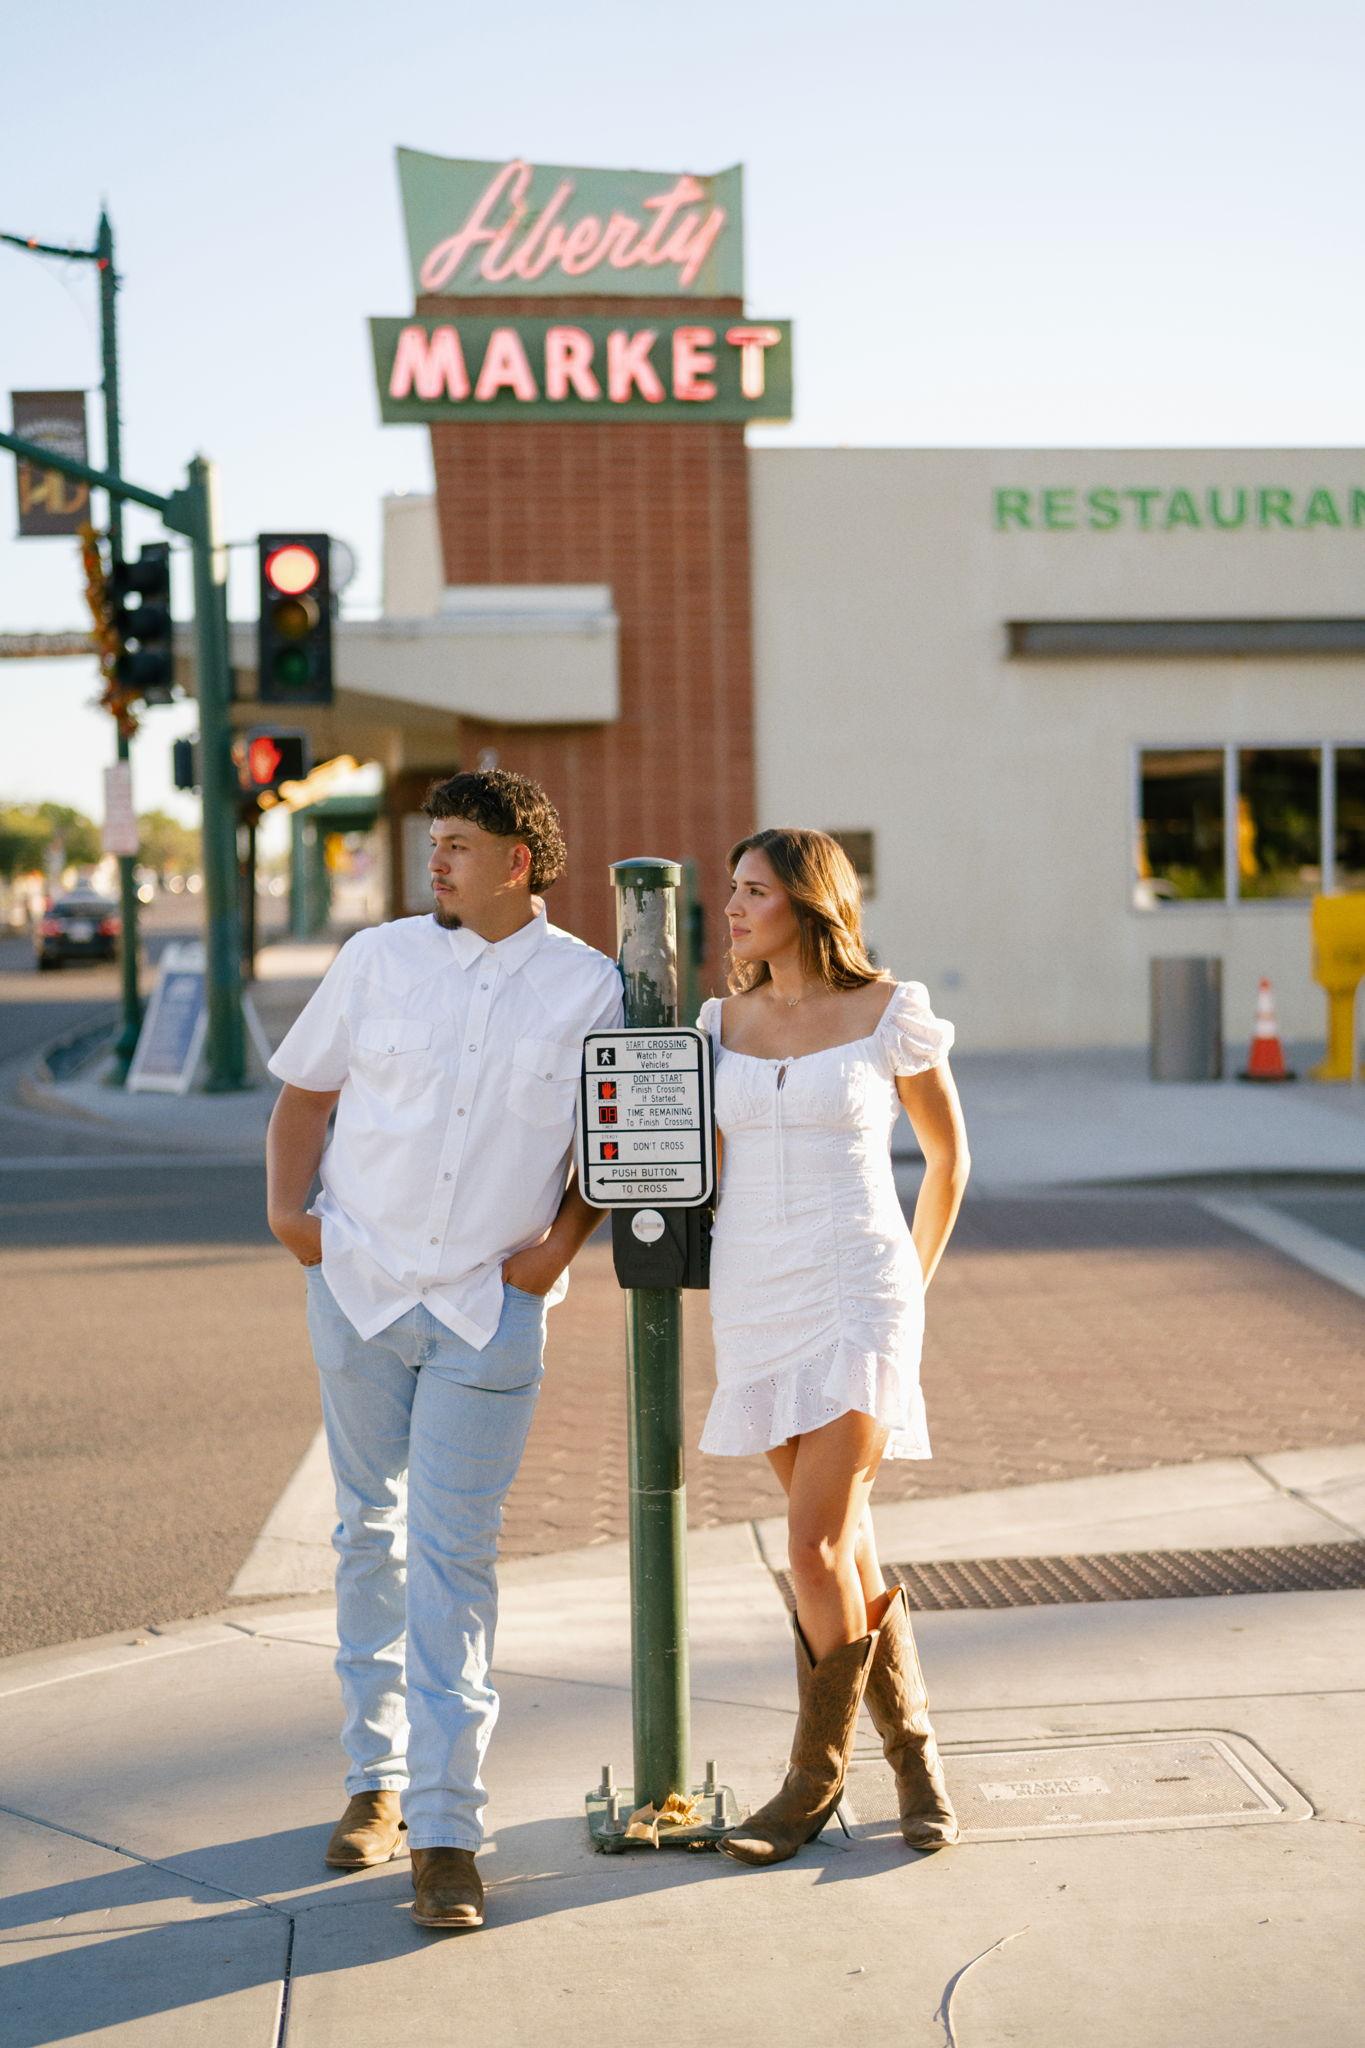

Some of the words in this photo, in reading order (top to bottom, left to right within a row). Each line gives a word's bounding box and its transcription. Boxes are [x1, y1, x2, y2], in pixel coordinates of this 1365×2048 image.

[419, 158, 726, 293] Liberty
[389, 324, 782, 403] MARKET
[647, 1040, 687, 1048] CROSSING
[636, 1052, 658, 1060] Watch
[641, 1061, 669, 1069] Vehicles
[633, 1075, 656, 1083] DON'T
[660, 1074, 682, 1082] START
[631, 1086, 652, 1094] Finish
[656, 1085, 685, 1095] Crossing
[651, 1095, 676, 1103] Started
[627, 1108, 645, 1116] TIME
[649, 1107, 692, 1116] REMAINING
[639, 1118, 660, 1126] Finish
[664, 1118, 693, 1127] Crossing
[633, 1142, 656, 1150] DON'T
[660, 1142, 684, 1150] CROSS
[612, 1169, 637, 1177] PUSH
[641, 1168, 677, 1177] BUTTON
[622, 1185, 633, 1193] TO
[637, 1184, 668, 1193] CROSS
